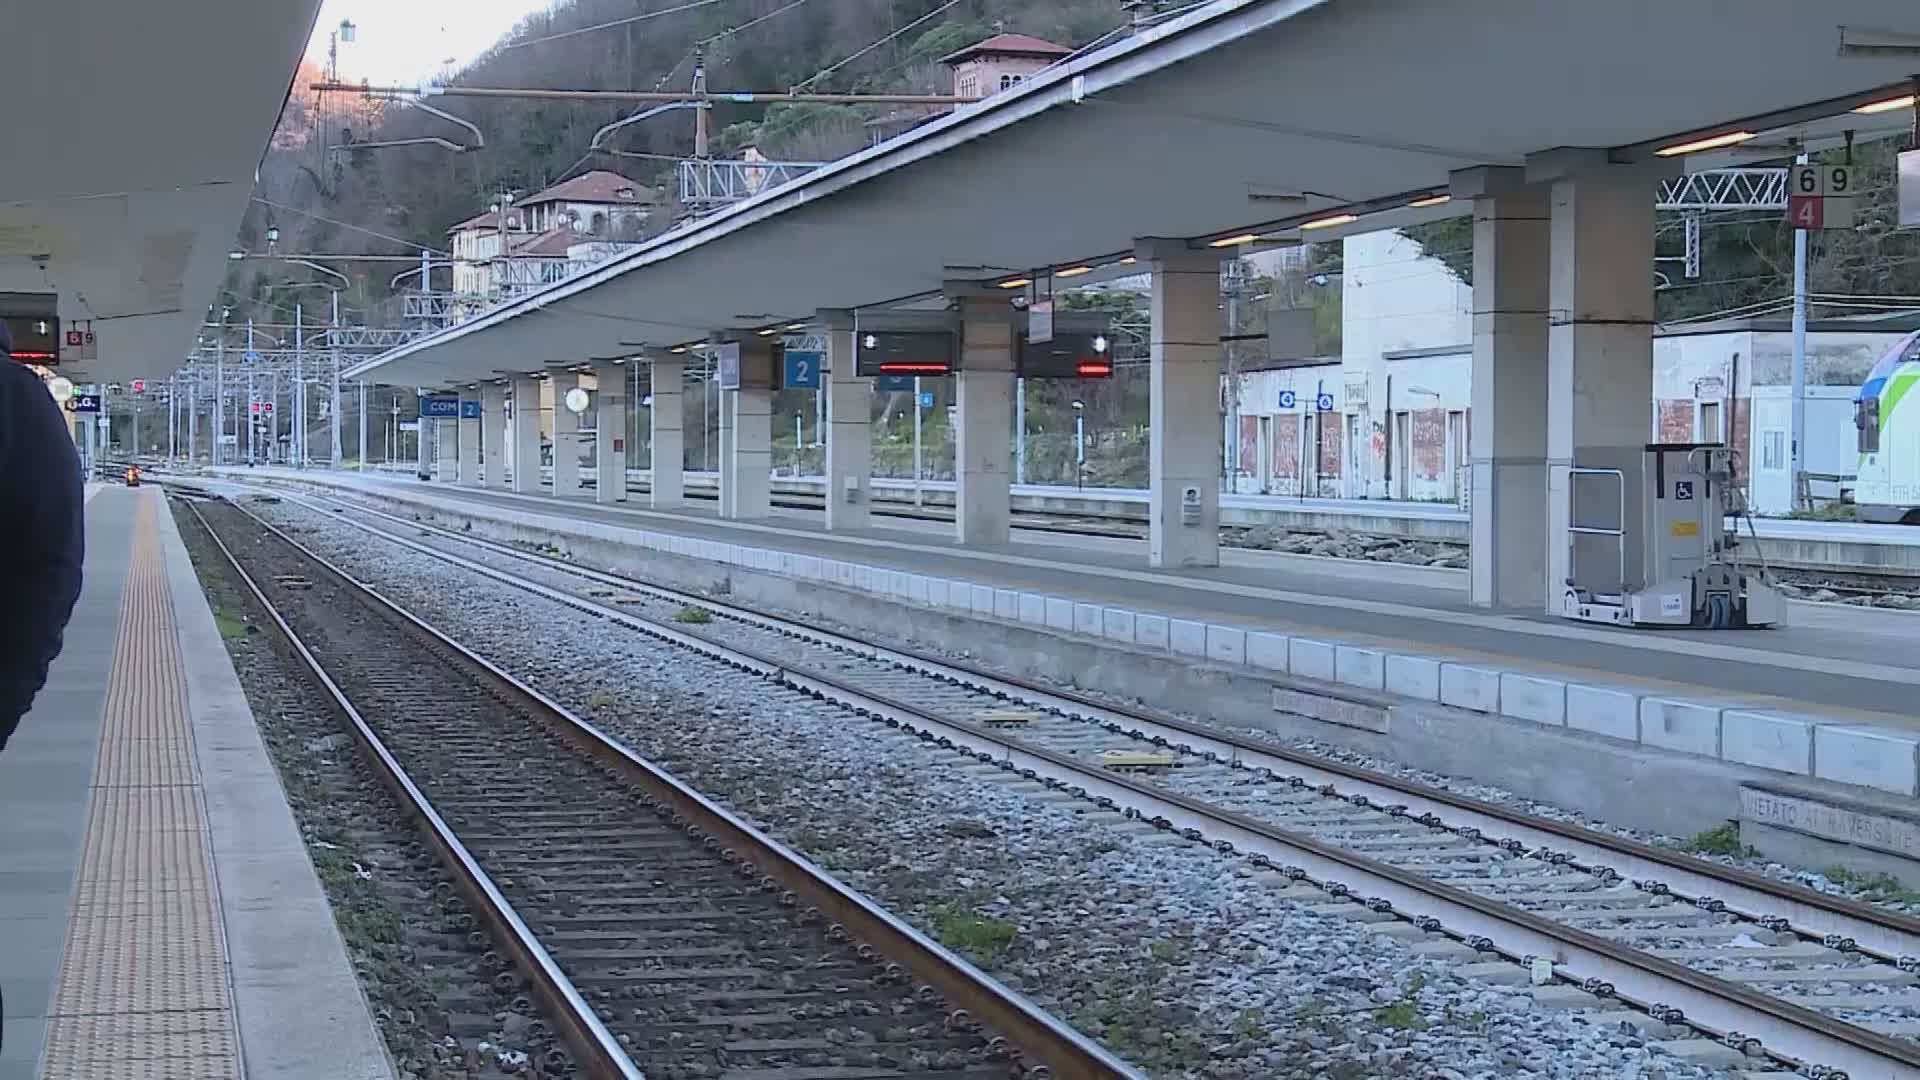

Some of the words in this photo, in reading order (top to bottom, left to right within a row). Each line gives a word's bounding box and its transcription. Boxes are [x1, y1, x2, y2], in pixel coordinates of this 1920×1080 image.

[1800, 169, 1816, 192] 6
[1832, 168, 1847, 192] 9
[1798, 200, 1815, 225] 4
[85, 333, 93, 343] 9
[795, 361, 809, 382] 2
[467, 404, 474, 416] 2
